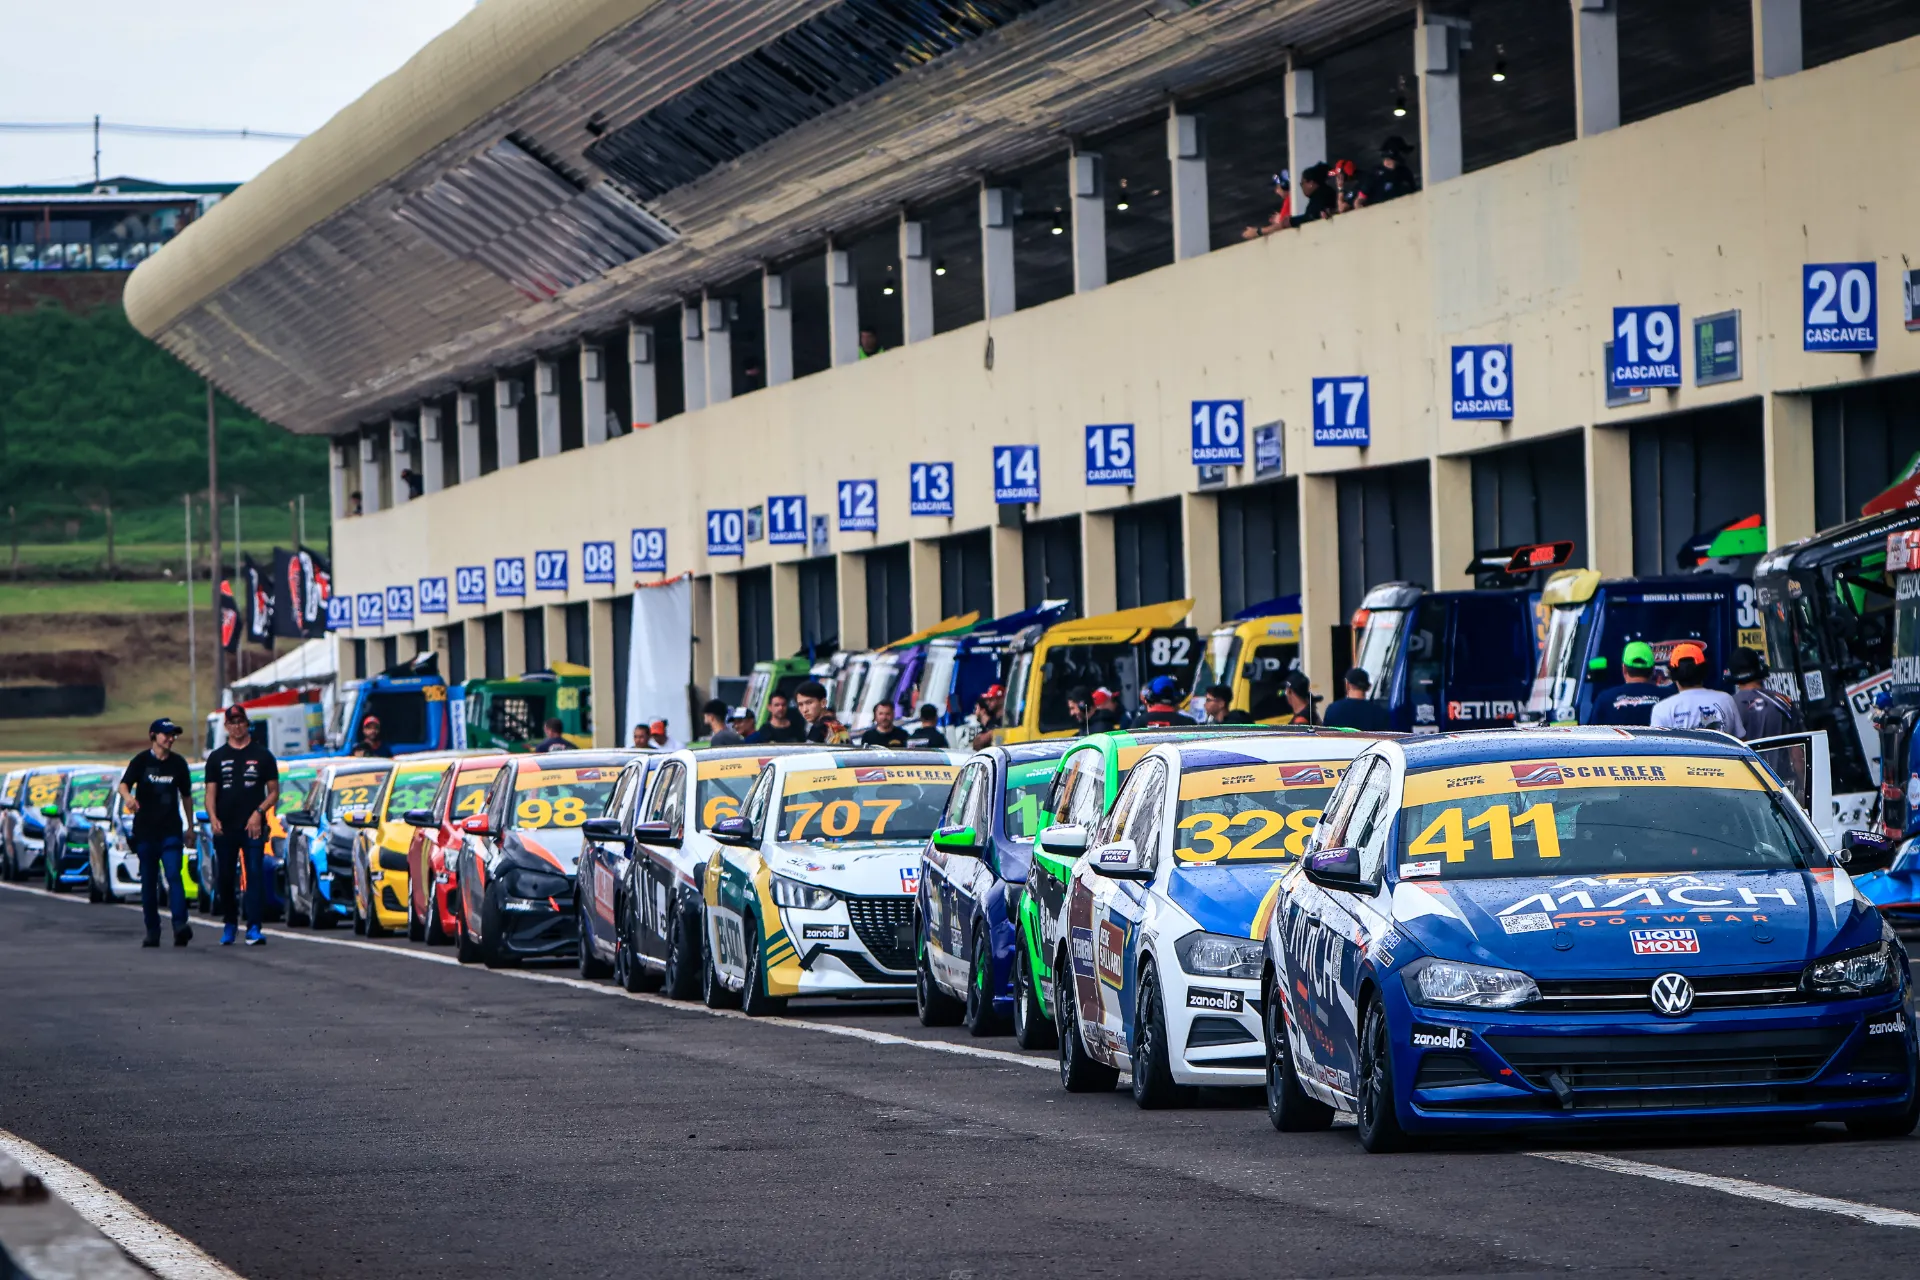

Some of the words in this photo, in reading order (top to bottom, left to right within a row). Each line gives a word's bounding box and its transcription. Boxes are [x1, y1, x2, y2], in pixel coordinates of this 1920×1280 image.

[1808, 269, 1871, 325] 20
[1618, 311, 1674, 362] 19
[1806, 328, 1874, 343] CASCAVEL
[1456, 349, 1508, 397] 18
[1616, 365, 1679, 380] CASCAVEL
[1317, 382, 1365, 426] 17
[1454, 399, 1512, 413] CASCAVEL
[1194, 404, 1239, 446] 16
[1315, 428, 1368, 440] CASCAVEL
[1088, 428, 1131, 468] 15
[1193, 447, 1242, 459] CASCAVEL
[996, 449, 1037, 487] 14
[1087, 469, 1134, 480] CASCAVEL
[912, 465, 950, 500] 13
[996, 487, 1038, 498] CASCAVEL
[840, 482, 875, 517] 12
[912, 501, 952, 511] CASCAVEL
[771, 499, 802, 531] 11
[840, 517, 876, 528] CASCAVEL
[709, 513, 741, 543] 10
[770, 531, 806, 541] CASCAVEL
[633, 531, 664, 561] 09
[708, 544, 743, 553] CASCAVEL
[537, 553, 566, 580] 07
[584, 544, 613, 573] 08
[458, 569, 484, 594] 05
[496, 560, 524, 587] 06
[388, 588, 412, 612] 03
[421, 580, 446, 604] 04
[1642, 593, 1680, 602] DOUGLAS
[1681, 592, 1713, 601] TORRES
[328, 598, 350, 619] 01
[358, 595, 382, 619] 02
[1151, 636, 1190, 666] 82
[887, 769, 951, 778] SCHERER
[1564, 765, 1664, 778] SCHERER
[1447, 779, 1485, 788] ELITE
[340, 787, 369, 805] 22
[517, 796, 588, 829] 98
[784, 799, 902, 841] 707
[1174, 809, 1324, 863] 328
[1408, 803, 1561, 863] 411
[1550, 875, 1704, 889] ALFA
[806, 925, 845, 939] zanoello
[1552, 914, 1769, 929] FOOTWEAR
[1634, 929, 1695, 941] LIQUI
[1634, 940, 1699, 953] MOLY
[1190, 991, 1238, 1010] zanoello
[1869, 1012, 1906, 1035] zanoello
[1413, 1028, 1466, 1049] zanoello
